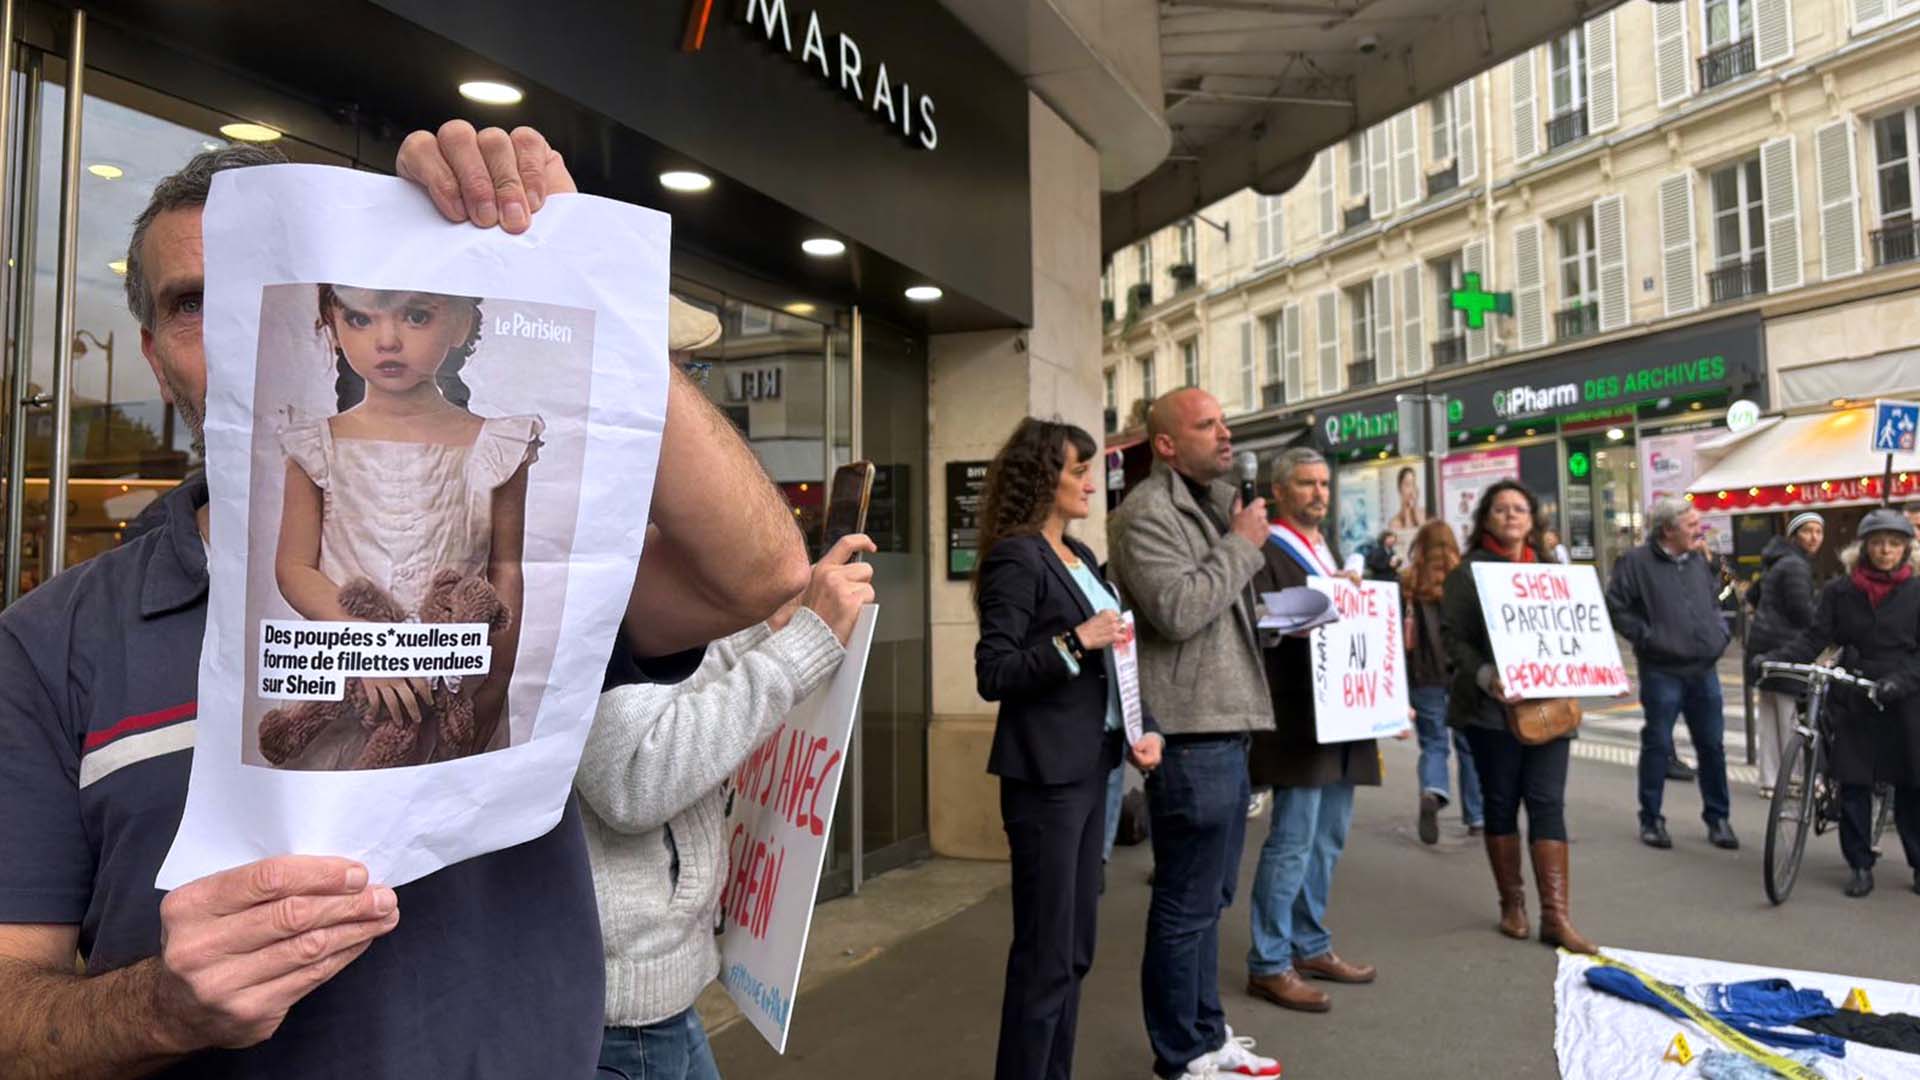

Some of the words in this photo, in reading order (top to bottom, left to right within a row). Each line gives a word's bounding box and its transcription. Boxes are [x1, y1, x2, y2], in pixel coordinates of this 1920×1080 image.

[746, 0, 938, 151] MARAIS
[495, 315, 511, 335] Le
[512, 311, 572, 344] Parisien
[1584, 376, 1619, 401] DES
[1624, 356, 1725, 393] ARCHIVES
[1334, 584, 1378, 619] HONTE
[265, 624, 292, 644] Des
[294, 627, 374, 649] poupées
[461, 632, 482, 646] en
[1348, 633, 1367, 671] AU
[1537, 632, 1551, 658] À
[1559, 635, 1582, 657] LA
[263, 648, 308, 670] forme
[311, 650, 334, 671] de
[337, 651, 410, 672] fillettes
[413, 652, 484, 671] vendues
[262, 676, 284, 693] sur
[286, 674, 336, 695] Shein
[1343, 671, 1378, 708] BHV
[774, 729, 841, 836] AVEC
